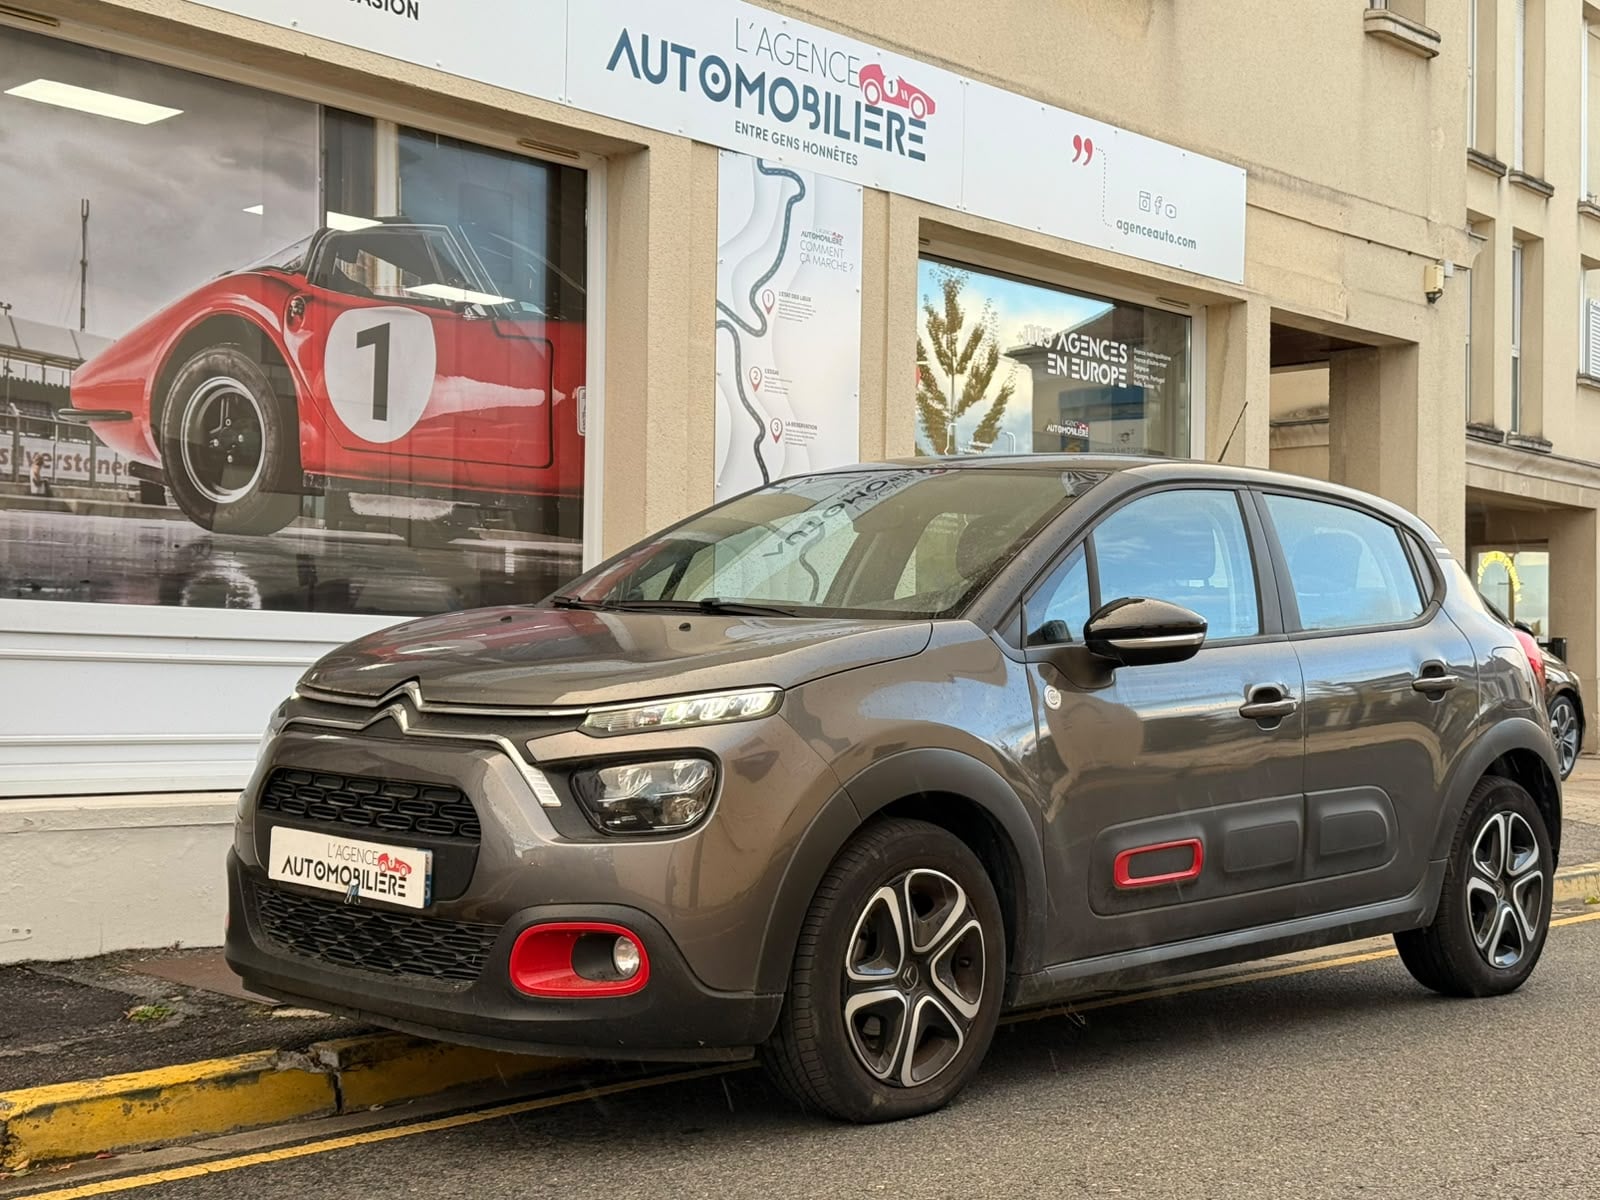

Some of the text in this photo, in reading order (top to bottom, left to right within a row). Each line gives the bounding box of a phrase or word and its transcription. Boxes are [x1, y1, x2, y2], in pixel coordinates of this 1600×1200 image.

[735, 17, 860, 89] L'AGENCE
[735, 120, 858, 166] ENTRE GENS HONNÊTES
[800, 239, 844, 259] COMMENT
[1116, 218, 1197, 250] agenceauto.com
[813, 255, 848, 273] MARCHE
[1056, 332, 1128, 365] AGENCES
[356, 322, 391, 422] 1
[753, 370, 759, 380] 2
[1047, 352, 1128, 389] EN EUROPE
[774, 421, 780, 432] 3
[327, 842, 379, 867] L'AGENCE
